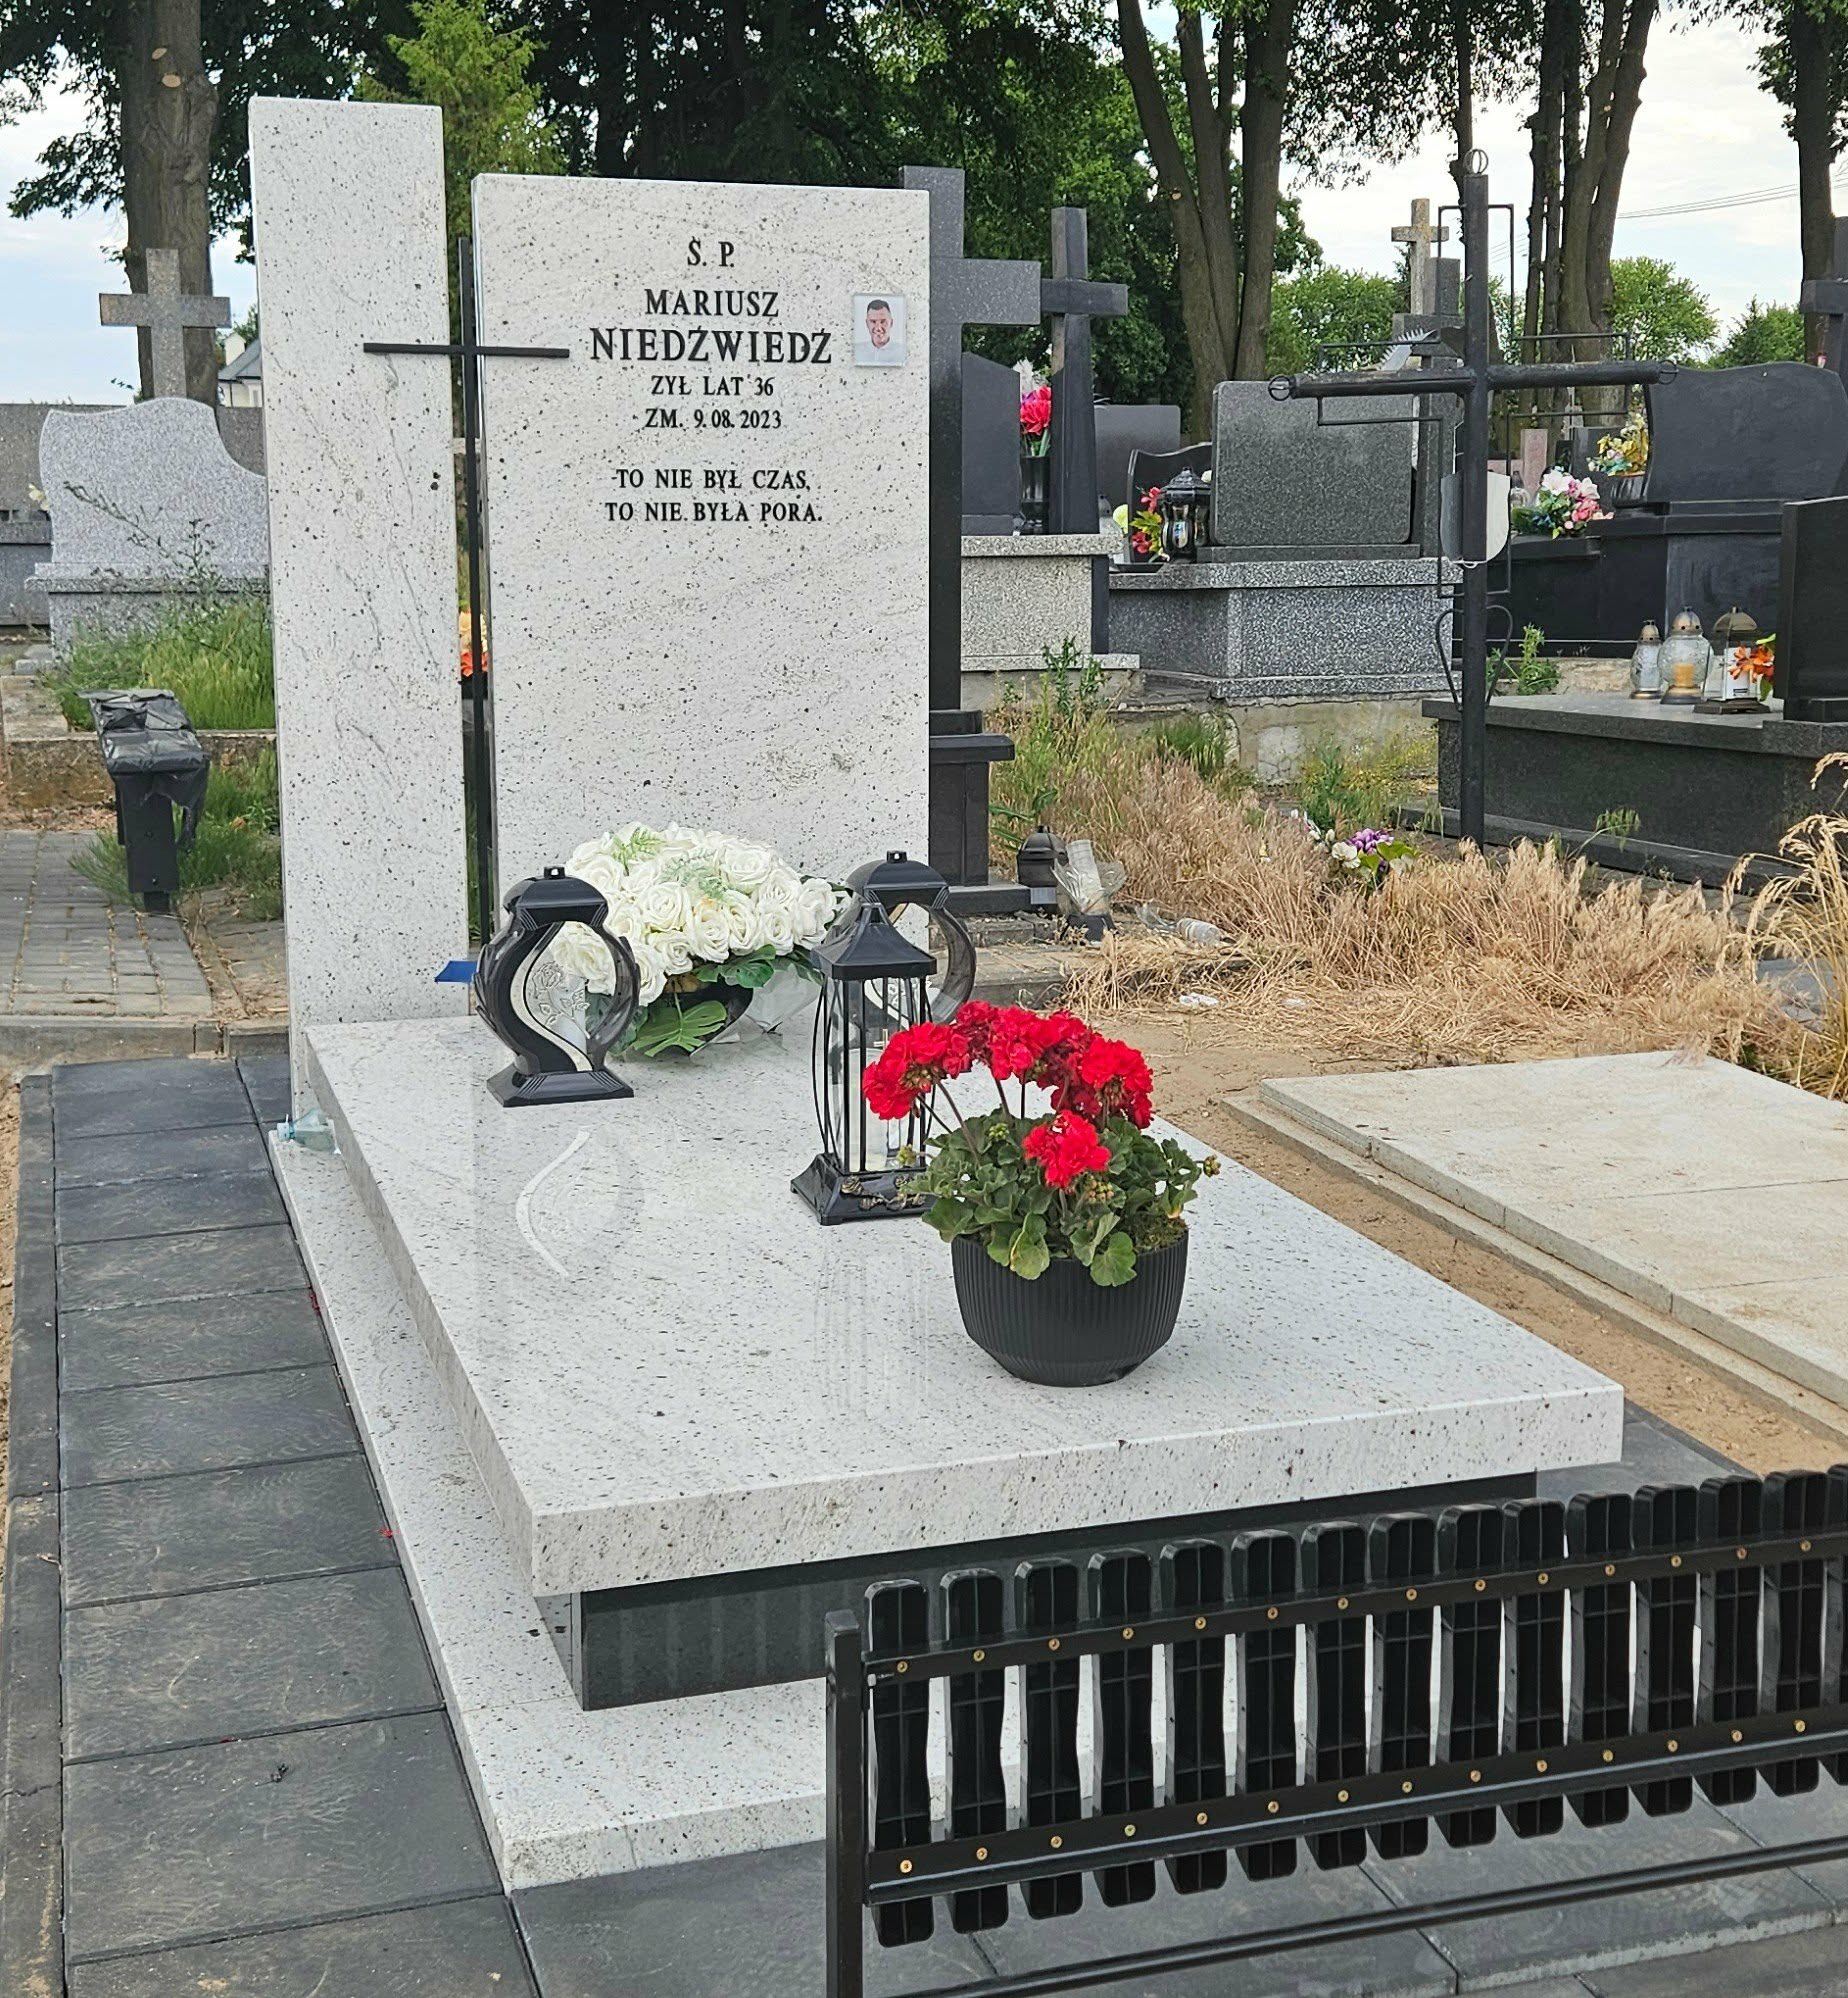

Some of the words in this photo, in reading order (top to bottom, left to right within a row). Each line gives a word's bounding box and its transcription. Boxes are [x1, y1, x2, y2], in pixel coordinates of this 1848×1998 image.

[644, 288, 779, 318] MARIUSZ
[590, 325, 832, 364] NIEDŹWIEDŹ
[703, 375, 744, 396] LAT
[754, 376, 775, 396] 36
[645, 408, 684, 428] ZM.
[655, 469, 693, 489] NIE
[703, 469, 742, 490] BYŁ
[605, 502, 633, 521] TO
[645, 502, 682, 522] NIE
[693, 502, 750, 522] BYŁA
[760, 502, 823, 522] PORA.
